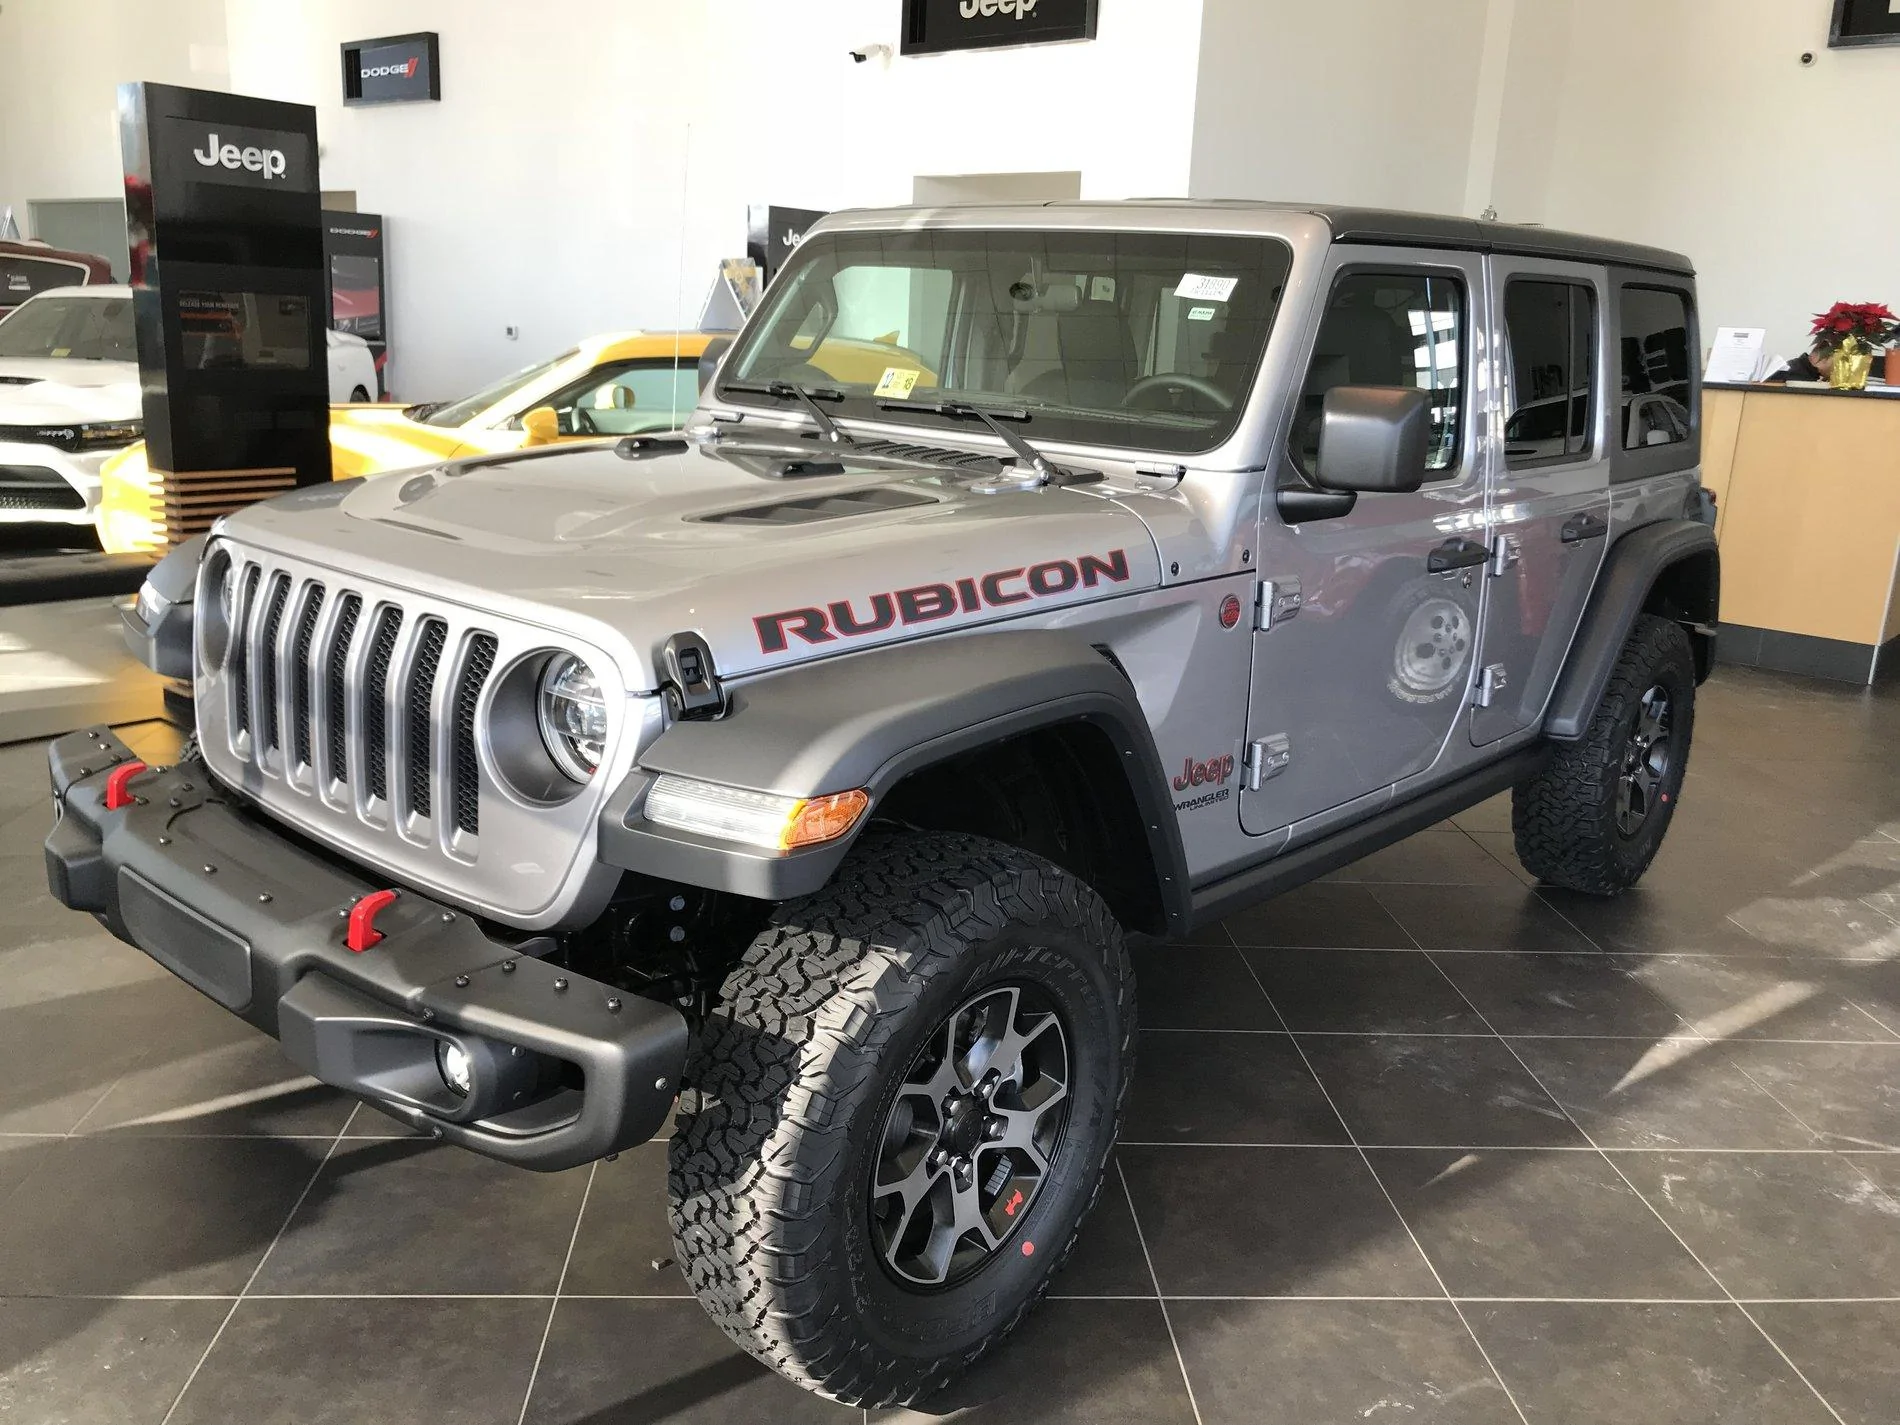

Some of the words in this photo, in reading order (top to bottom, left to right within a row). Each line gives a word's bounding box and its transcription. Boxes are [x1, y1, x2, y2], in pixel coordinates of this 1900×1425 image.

[361, 63, 408, 79] DODGE
[194, 133, 285, 180] Jeep
[752, 549, 1130, 654] RUBICON
[1174, 754, 1235, 791] Jeep
[1174, 789, 1229, 812] WRANGLER
